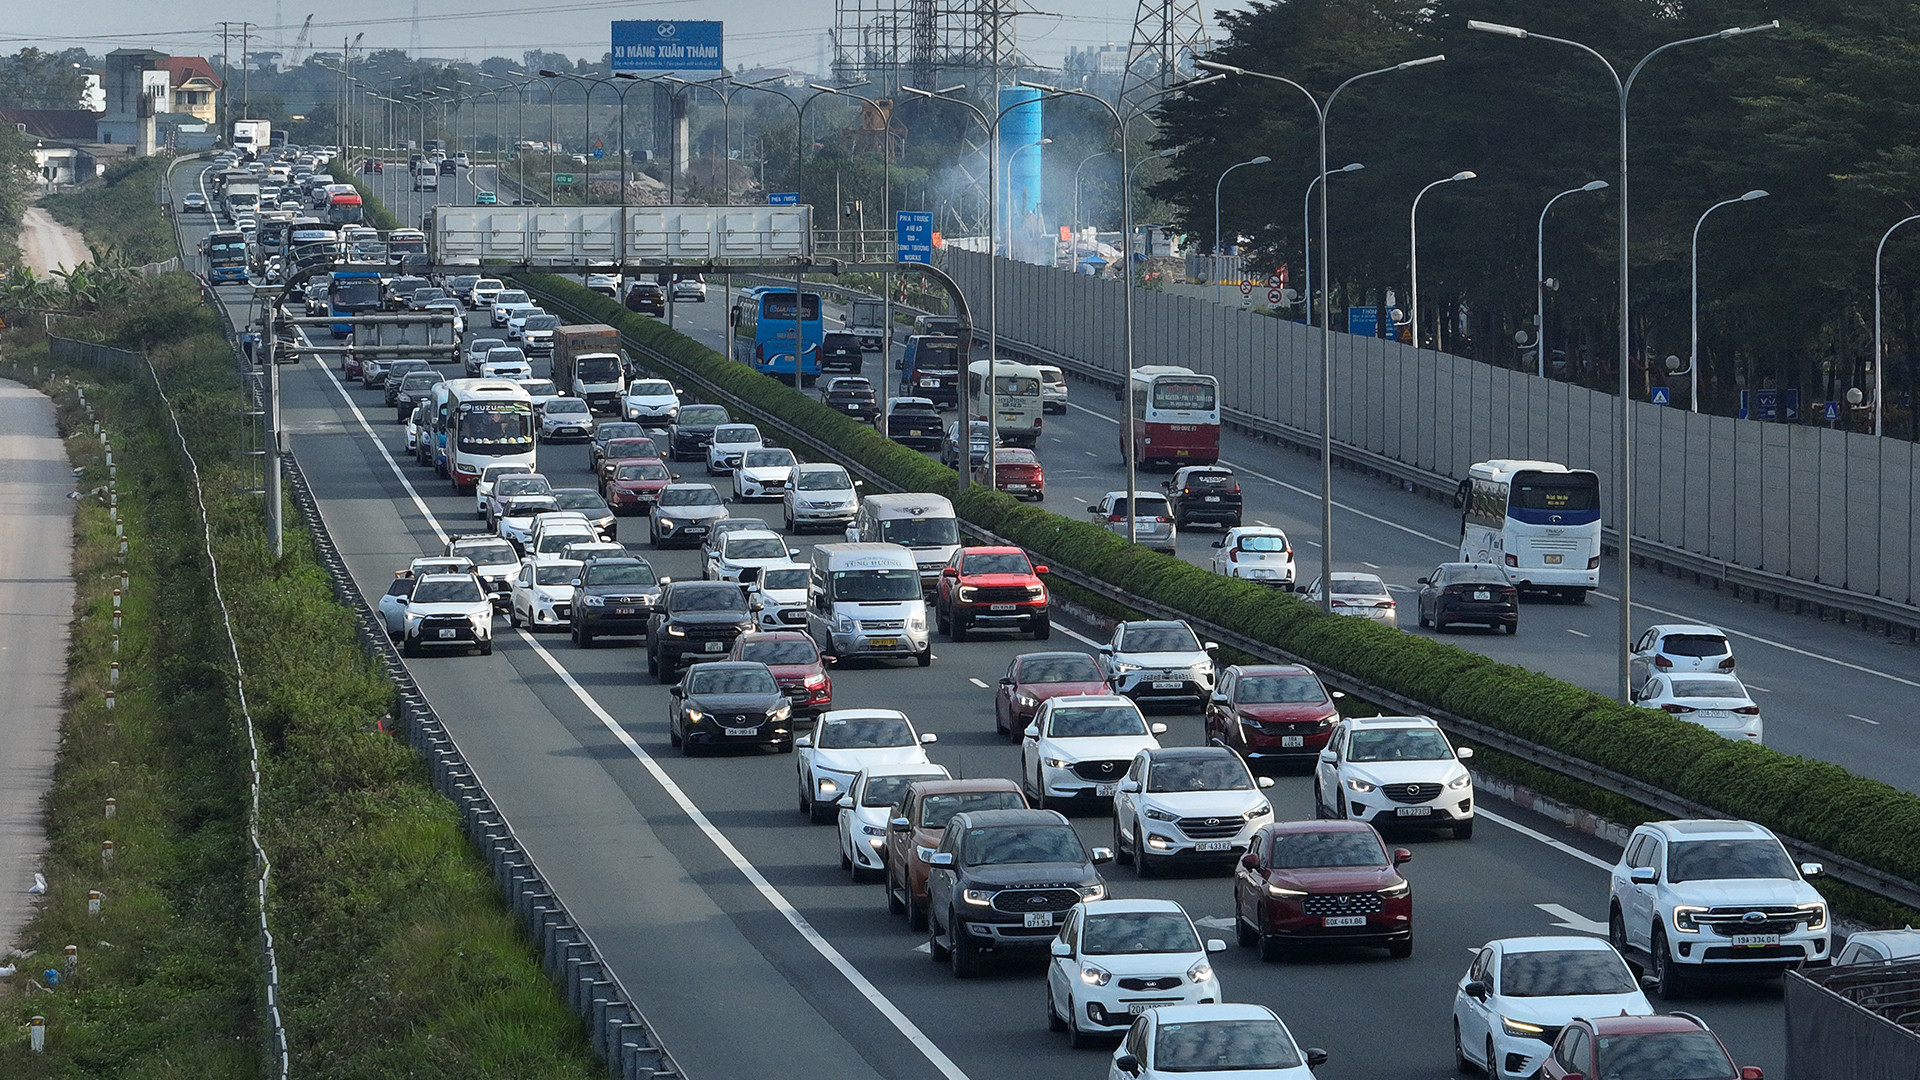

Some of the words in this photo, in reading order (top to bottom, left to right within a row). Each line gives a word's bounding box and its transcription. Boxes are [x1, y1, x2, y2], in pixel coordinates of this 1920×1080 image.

[615, 46, 624, 57] XI
[627, 43, 655, 58] MĂNG
[658, 43, 684, 58] XUÂN
[686, 43, 718, 58] THÀNH
